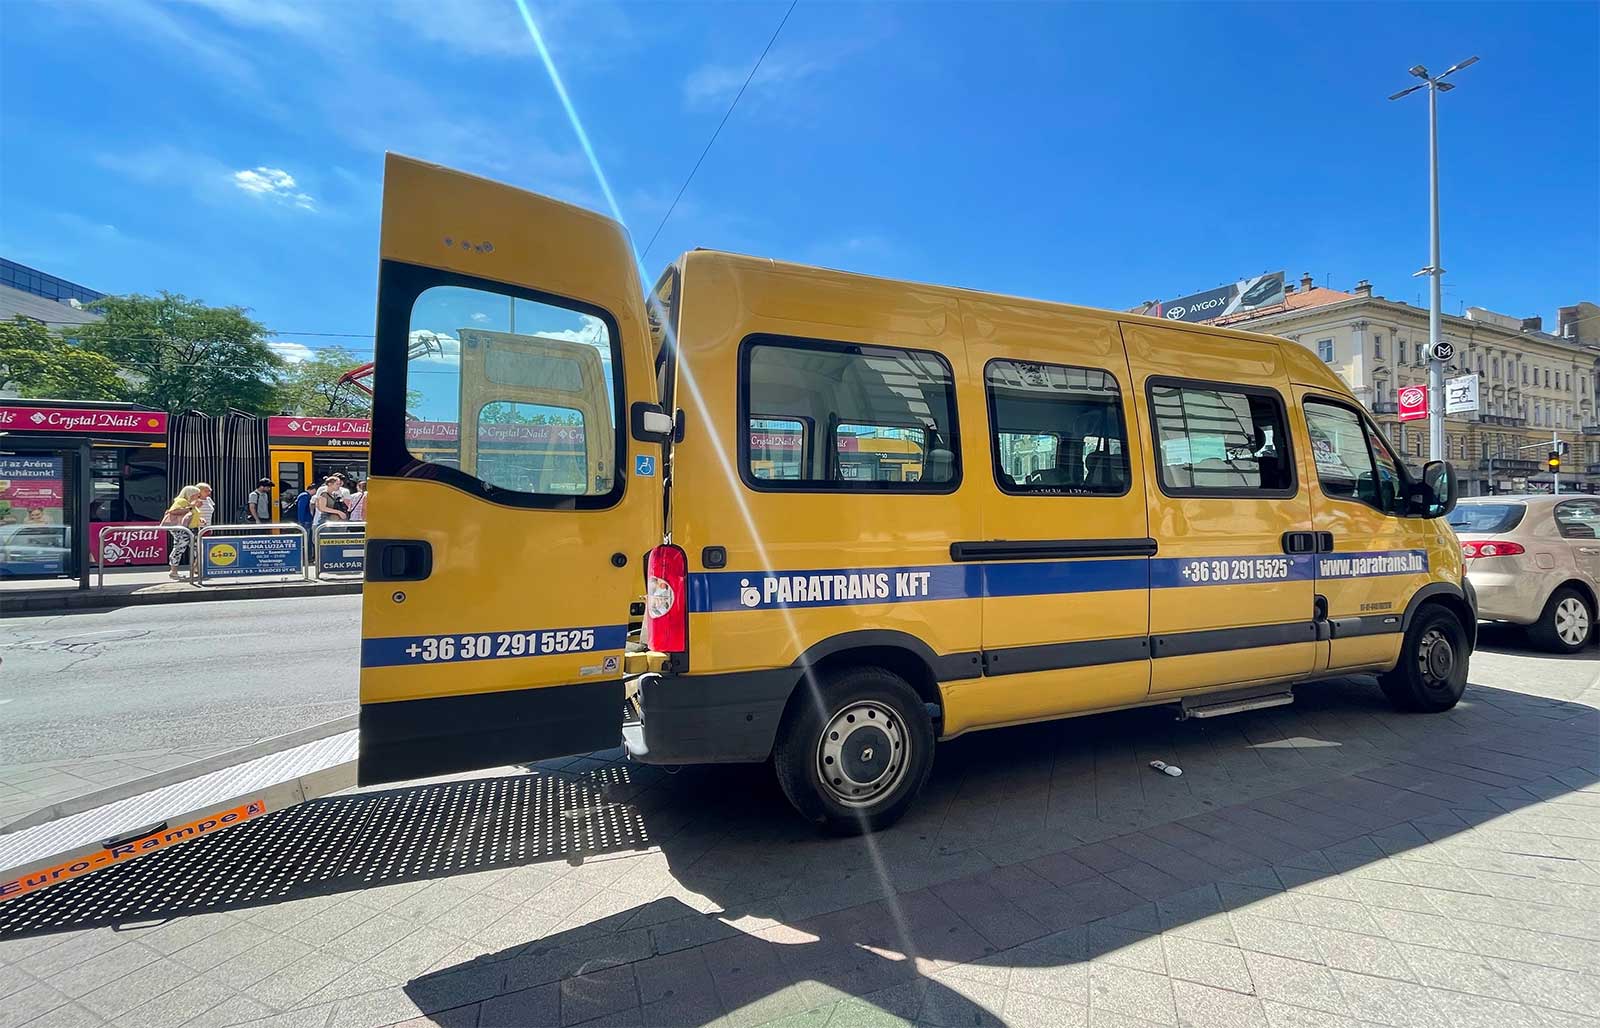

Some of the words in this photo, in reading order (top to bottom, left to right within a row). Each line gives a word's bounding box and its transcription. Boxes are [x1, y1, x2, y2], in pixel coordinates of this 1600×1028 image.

[1190, 299, 1216, 313] AYGO
[1217, 296, 1226, 305] X
[48, 412, 96, 430] Crystal
[98, 414, 140, 427] Nails
[302, 420, 340, 436] Crystal
[405, 425, 434, 439] rystal
[488, 426, 520, 440] Crystal
[118, 545, 160, 559] Nails
[1182, 560, 1209, 582] +36
[1212, 560, 1229, 581] 30
[1231, 559, 1254, 580] 291
[1256, 558, 1288, 578] 5525
[763, 573, 889, 604] PARATRANS
[895, 571, 931, 597] KFT
[405, 637, 455, 661] +36
[461, 636, 491, 659] 30
[496, 632, 537, 656] 291
[541, 629, 595, 652] 5525
[0, 812, 238, 896] Euro-Rampe
